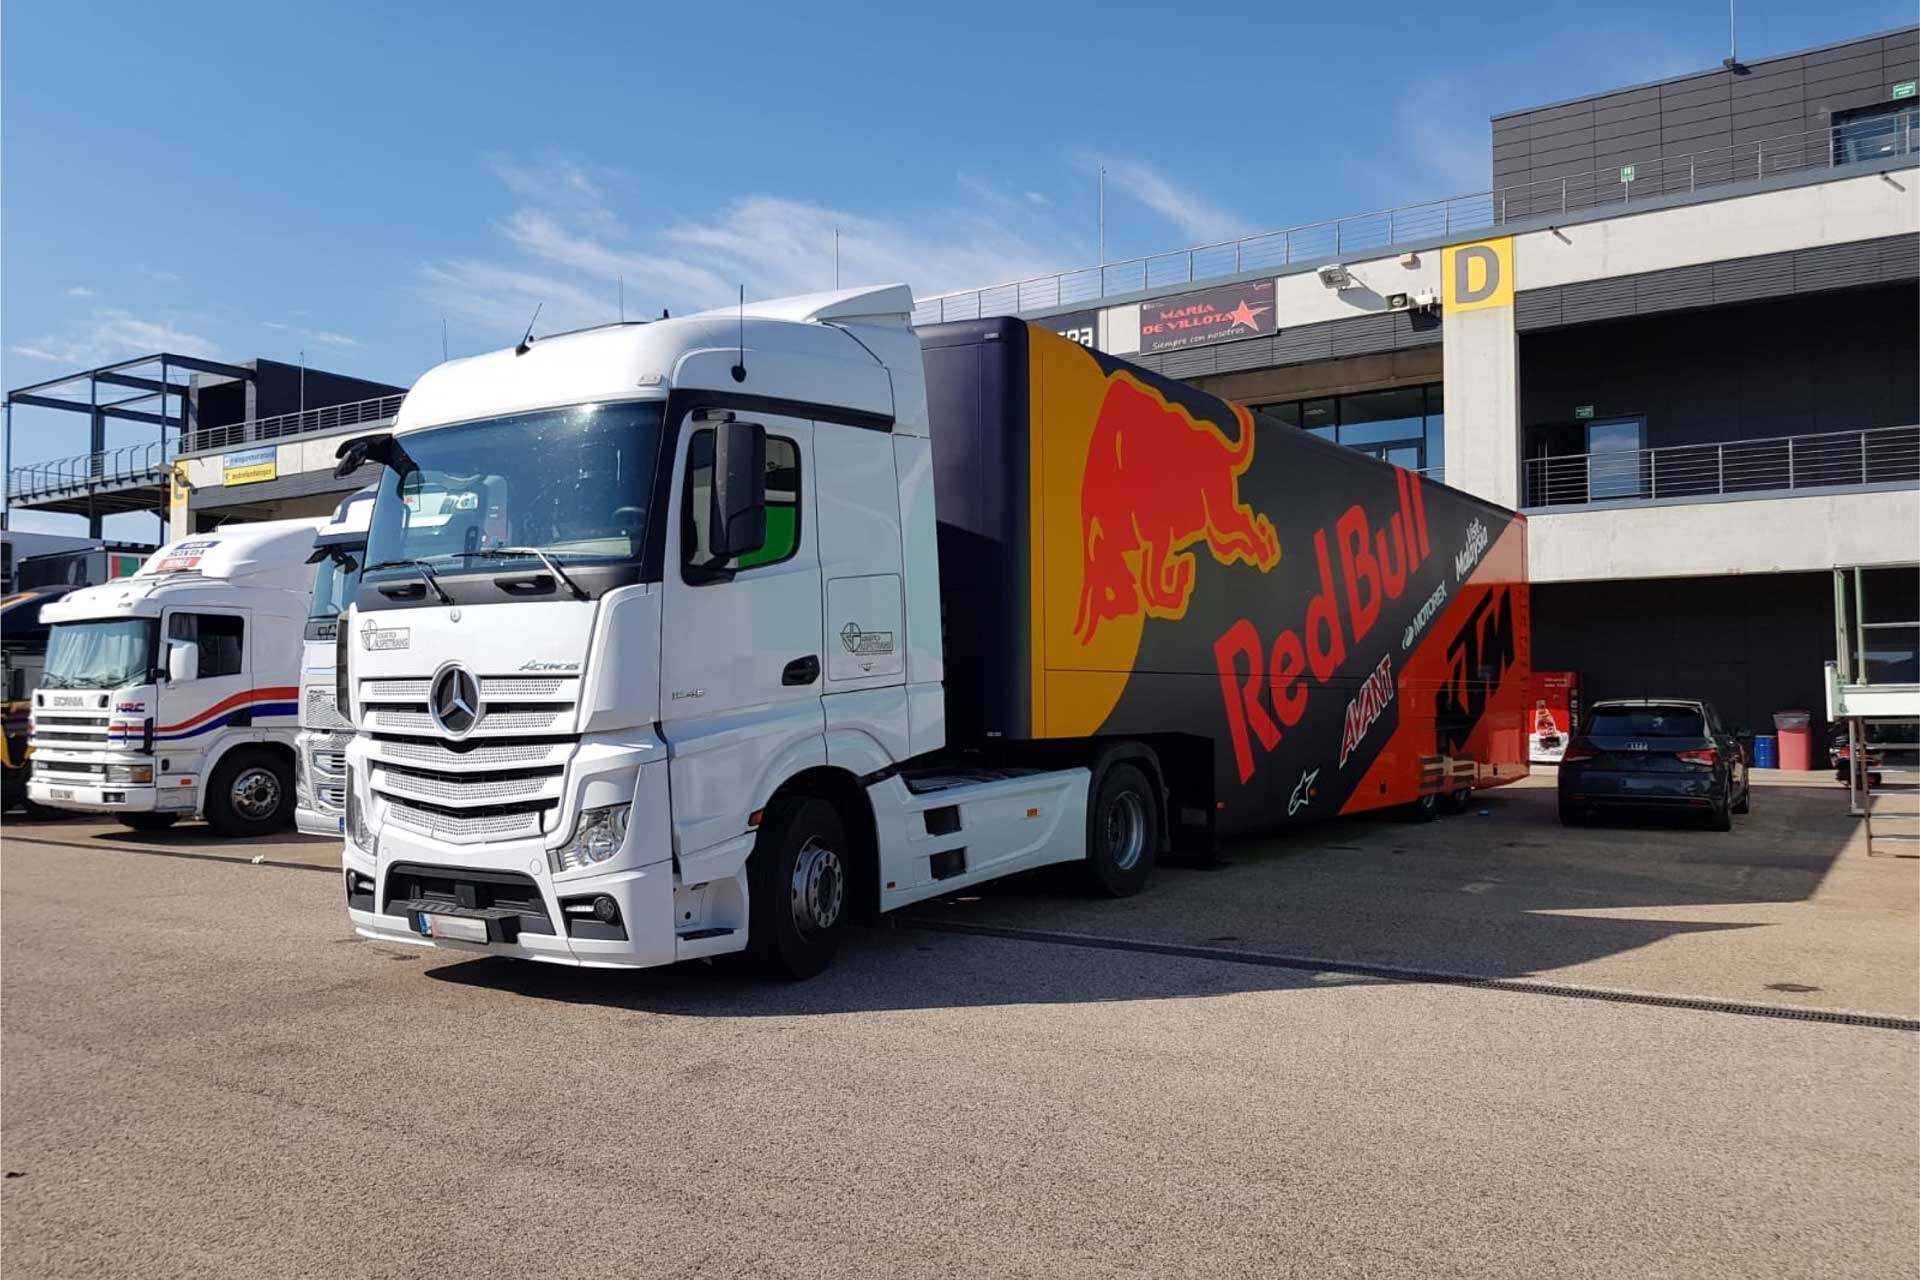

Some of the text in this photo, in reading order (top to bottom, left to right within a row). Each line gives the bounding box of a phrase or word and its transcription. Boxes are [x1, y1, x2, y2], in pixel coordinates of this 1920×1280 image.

[1455, 245, 1500, 304] D
[1142, 312, 1235, 335] DE VILLOTA
[1160, 304, 1216, 320] MARÍA
[1151, 326, 1246, 351] Siempre con nosotros
[1213, 527, 1346, 785] Red
[1335, 465, 1431, 644] Bull
[1412, 579, 1447, 637] MOTOREX
[1435, 583, 1515, 755] KTM
[54, 697, 84, 706] SCANIA
[116, 703, 145, 713] HRC
[1340, 653, 1395, 771] AVANT
